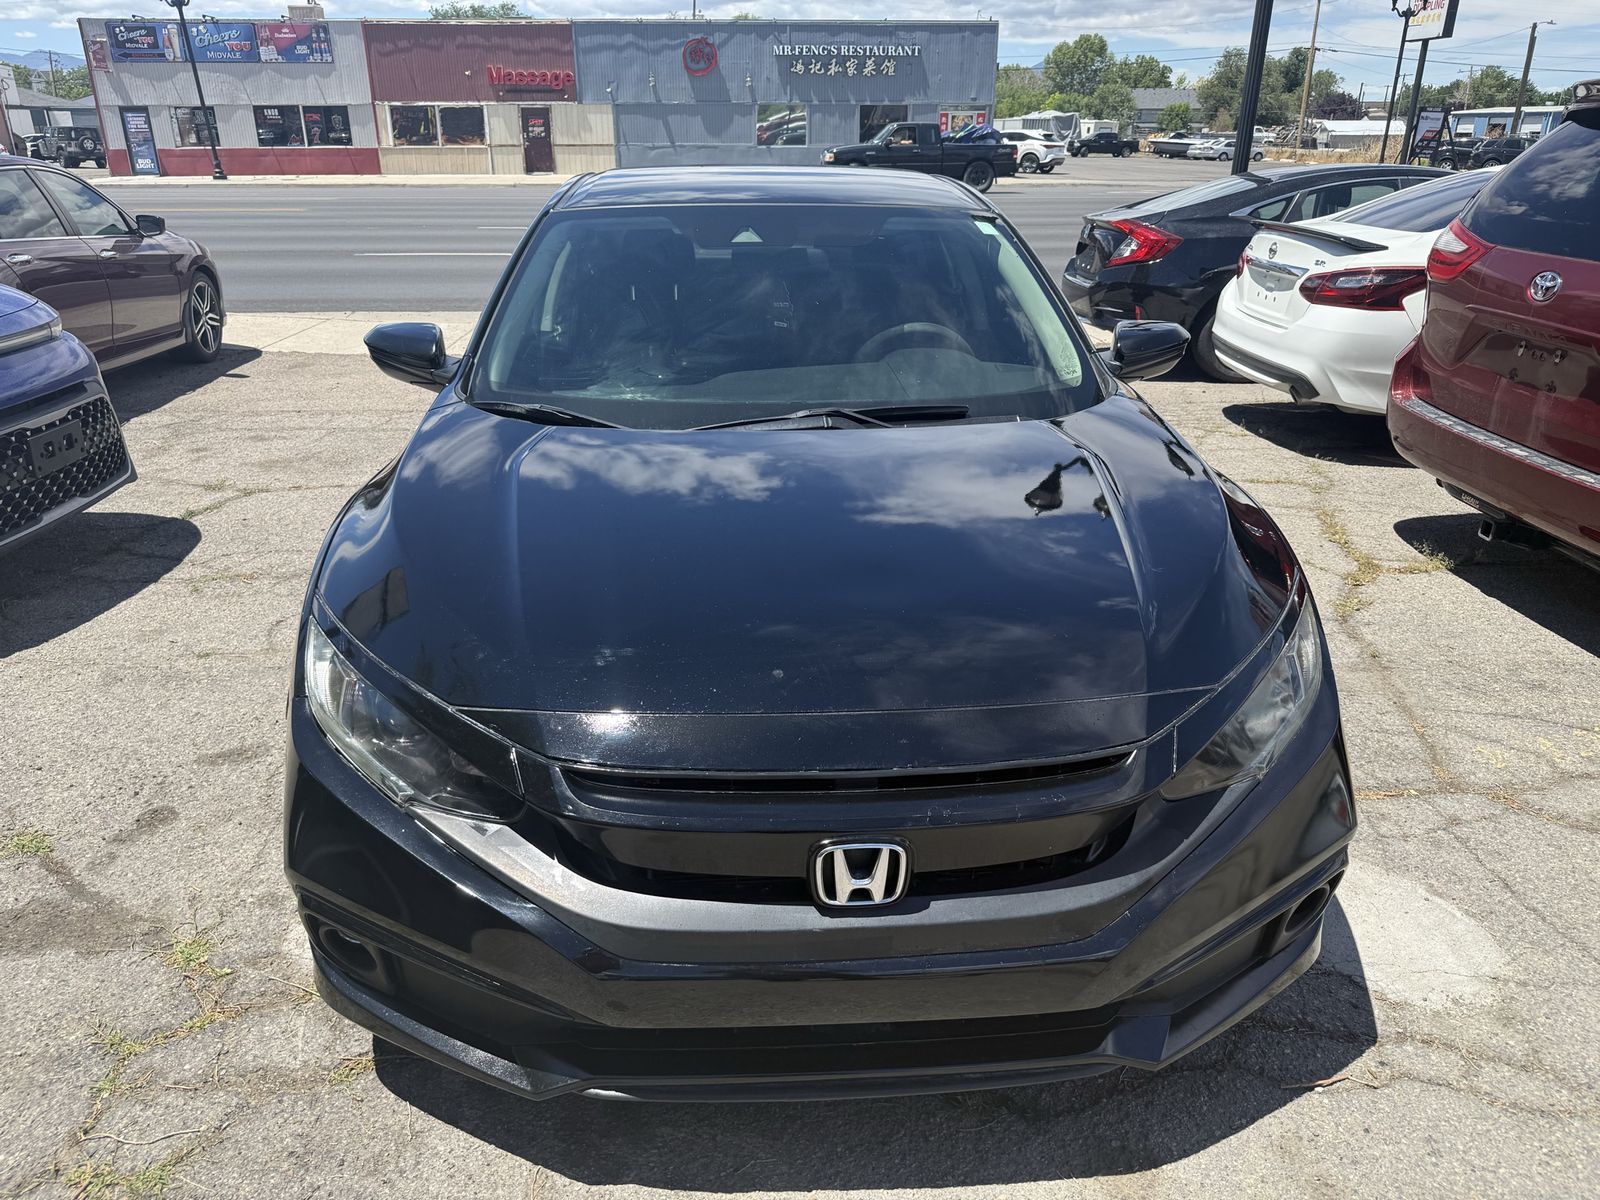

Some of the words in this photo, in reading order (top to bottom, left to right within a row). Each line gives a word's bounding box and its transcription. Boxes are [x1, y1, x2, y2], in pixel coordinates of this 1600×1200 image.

[1413, 0, 1445, 11] DUPLING
[118, 29, 148, 41] Cheers
[136, 36, 154, 44] YOU
[195, 29, 240, 48] Cheers
[224, 41, 252, 51] YOU
[772, 45, 838, 56] MR.FENG'S
[840, 45, 921, 56] RESTAURANT
[207, 50, 242, 59] MIDVALE
[487, 64, 575, 90] Massage
